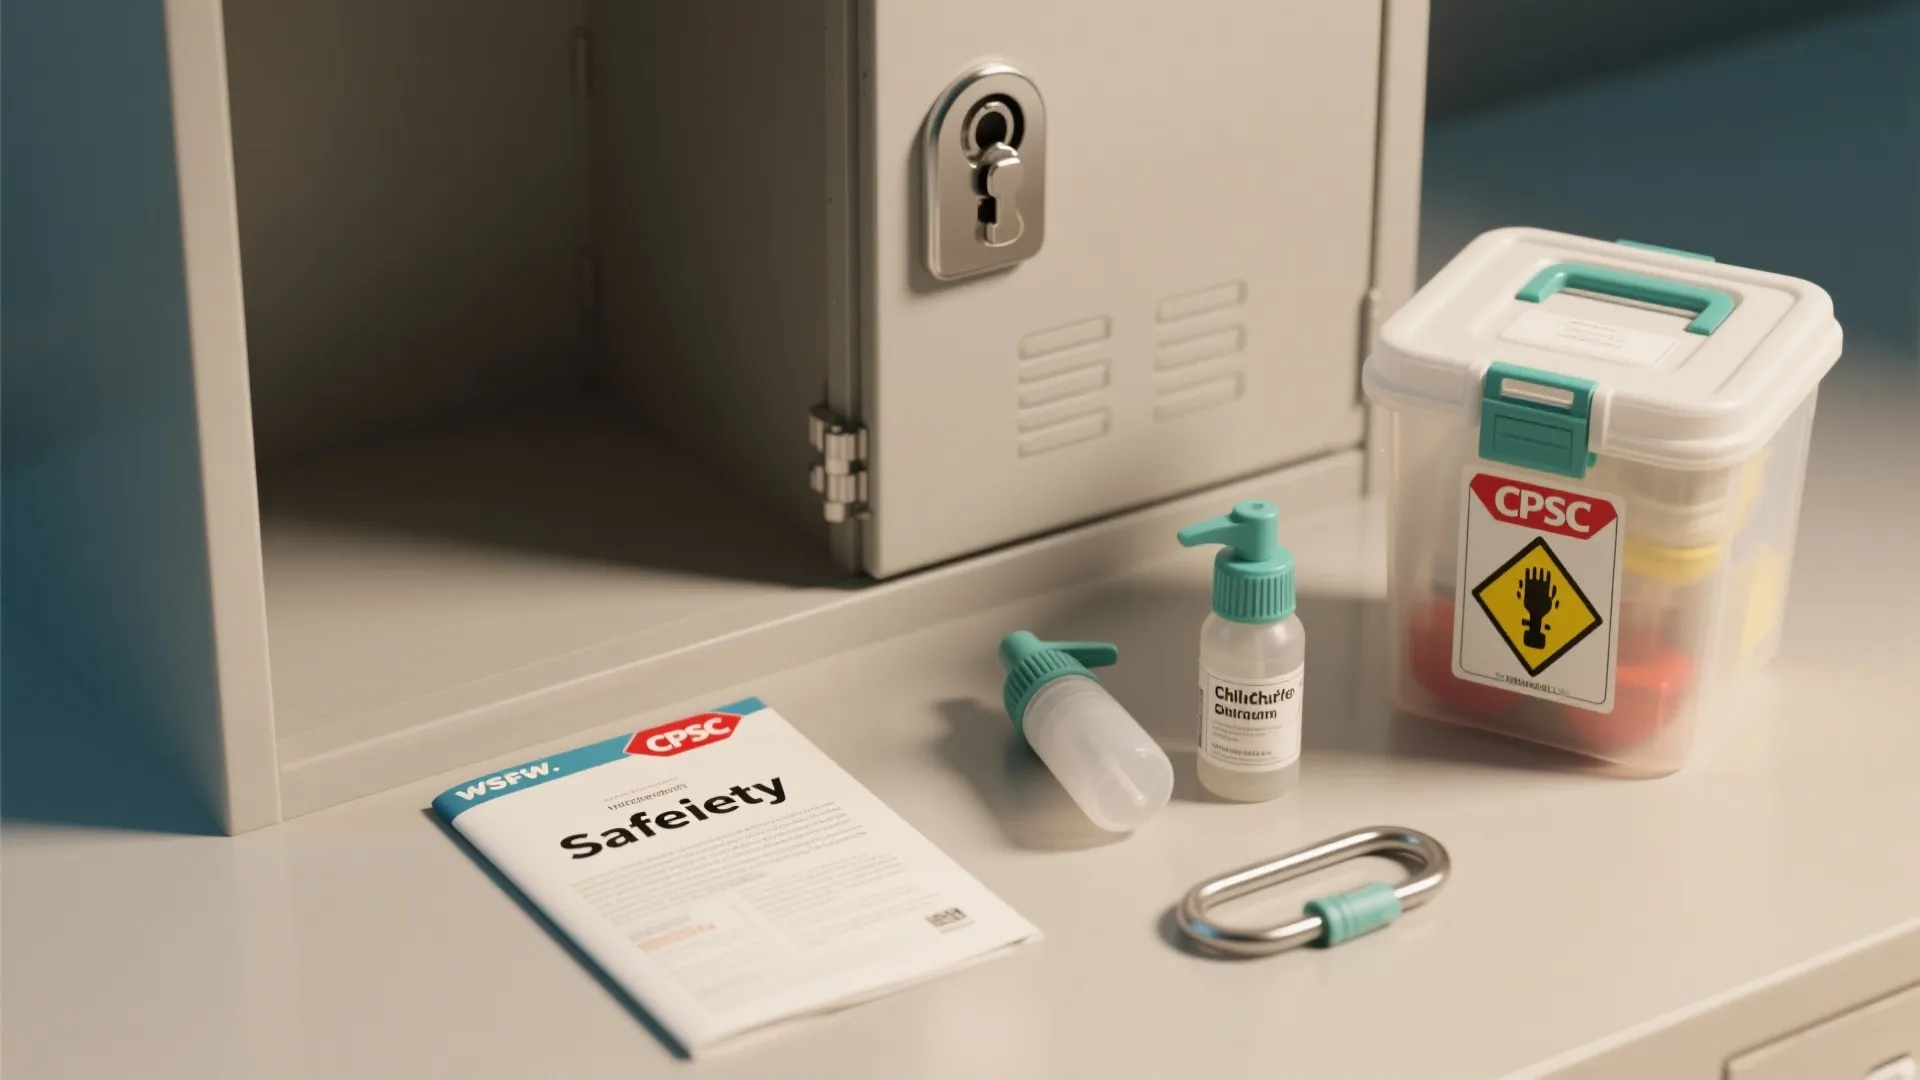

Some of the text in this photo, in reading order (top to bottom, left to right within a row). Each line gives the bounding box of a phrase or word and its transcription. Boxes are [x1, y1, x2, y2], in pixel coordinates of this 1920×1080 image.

[1494, 485, 1592, 533] CPSC
[645, 717, 732, 753] CPSC
[560, 776, 786, 860] Safeiety
